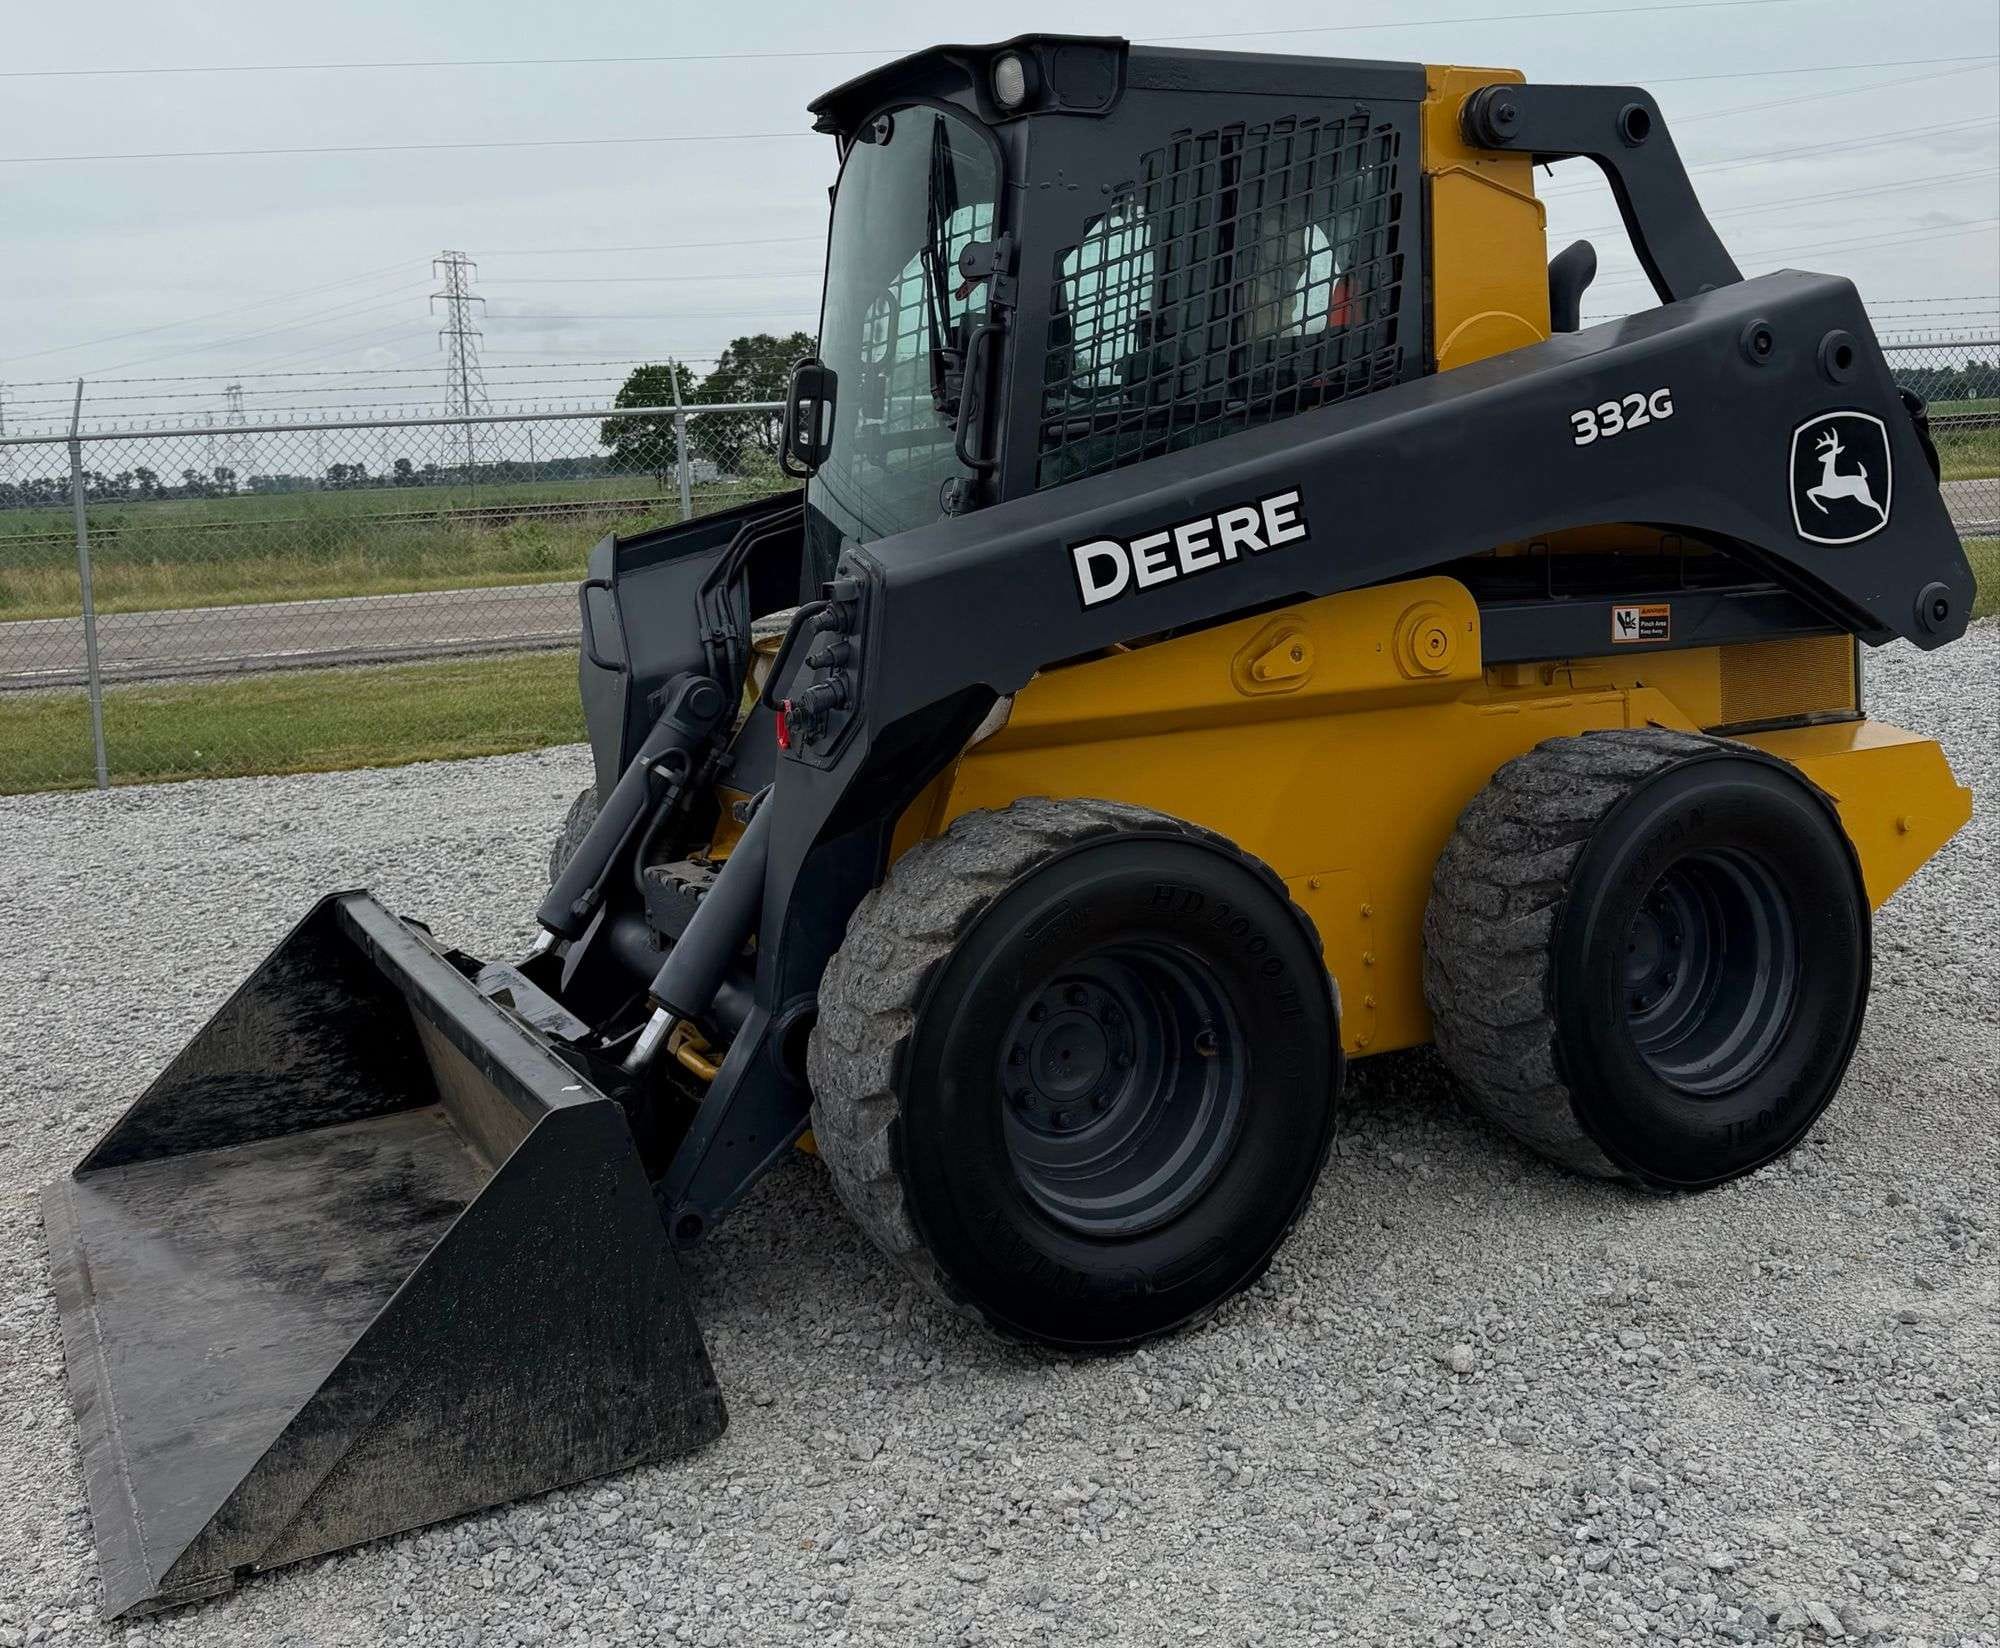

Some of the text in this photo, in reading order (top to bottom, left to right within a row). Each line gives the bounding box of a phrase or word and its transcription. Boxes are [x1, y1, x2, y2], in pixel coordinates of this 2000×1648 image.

[1570, 388, 1674, 446] 332G
[1072, 490, 1306, 606] DEERE
[1150, 883, 1205, 914] HD
[1208, 902, 1286, 979] 2000
